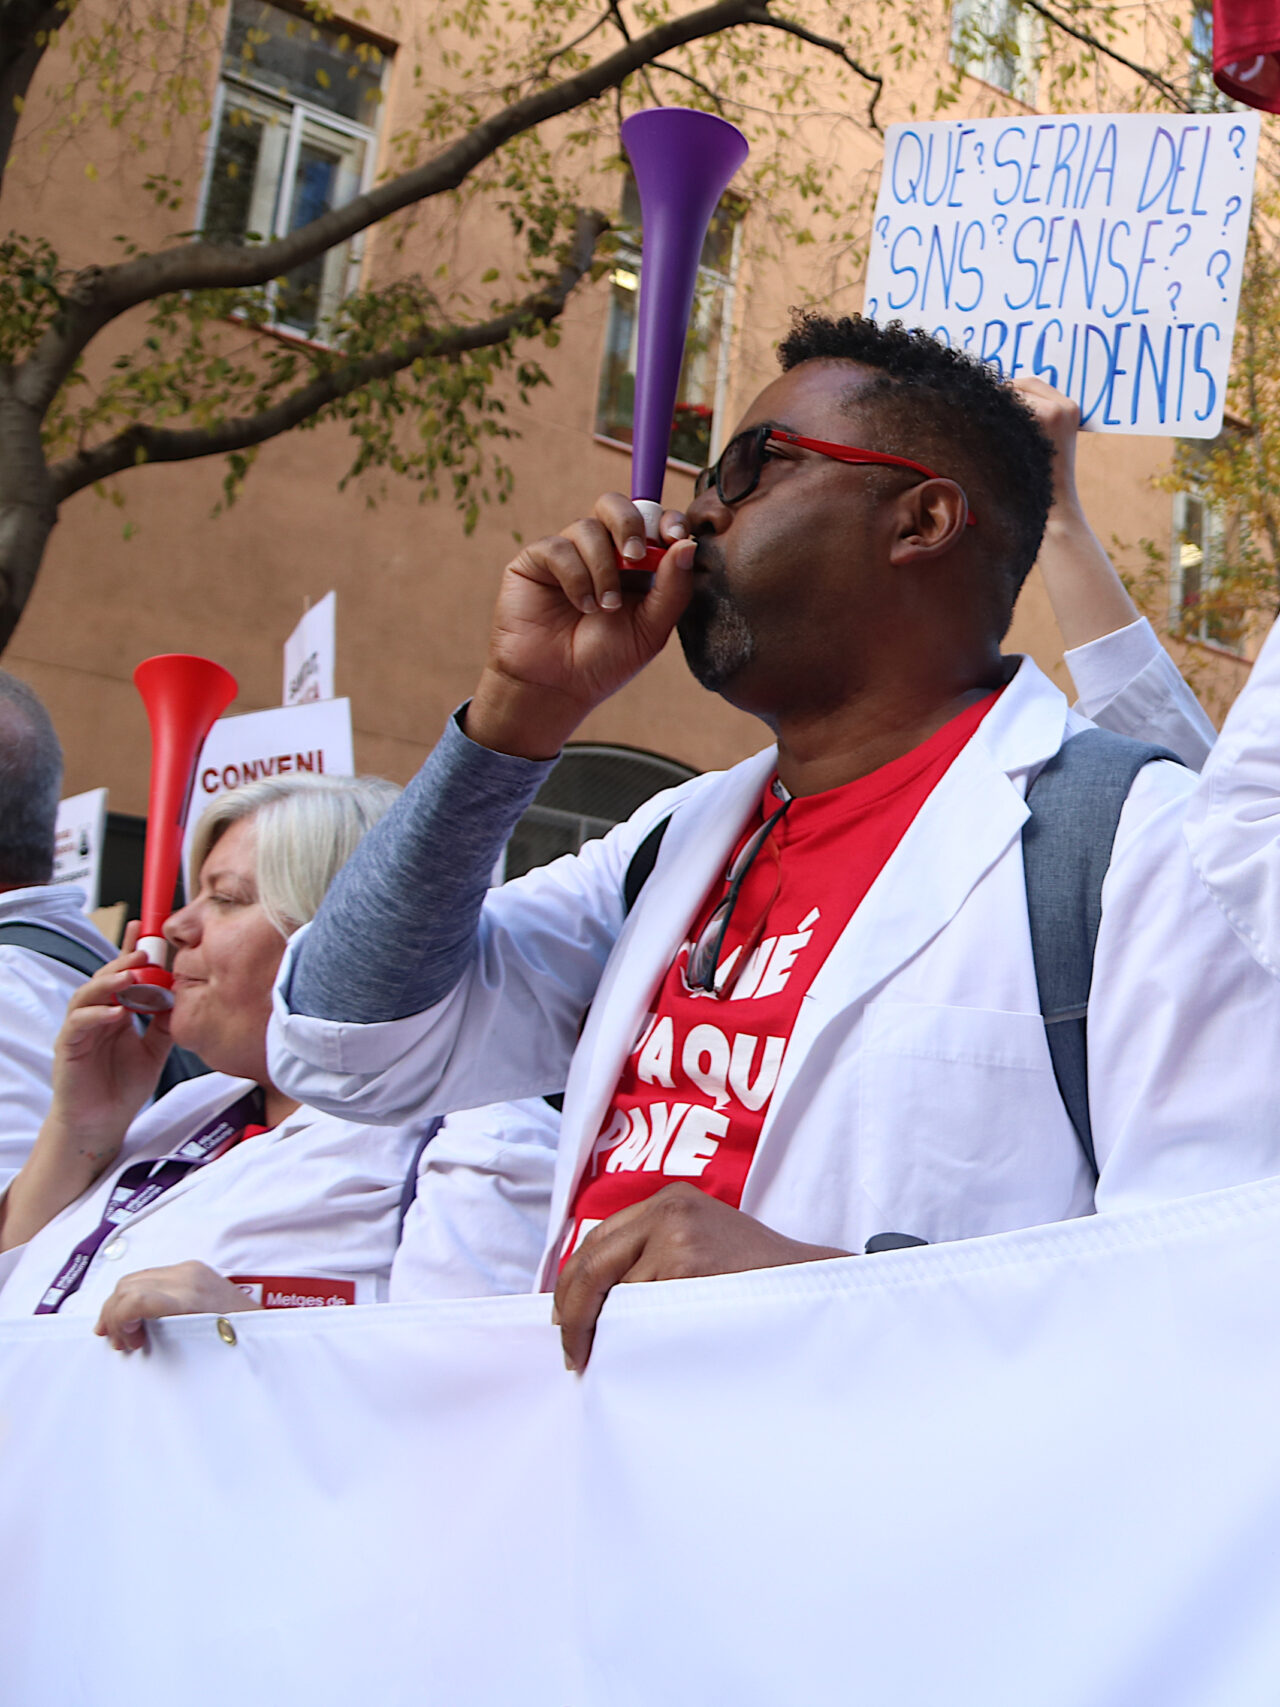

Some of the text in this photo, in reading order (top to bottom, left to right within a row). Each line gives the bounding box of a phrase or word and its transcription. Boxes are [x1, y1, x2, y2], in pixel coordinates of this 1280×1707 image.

[993, 123, 1118, 209] SERIA
[1137, 126, 1211, 216] DEL
[980, 318, 1220, 425] RESIDENTS
[202, 748, 324, 794] CONVENI
[265, 1291, 347, 1308] Metges de
